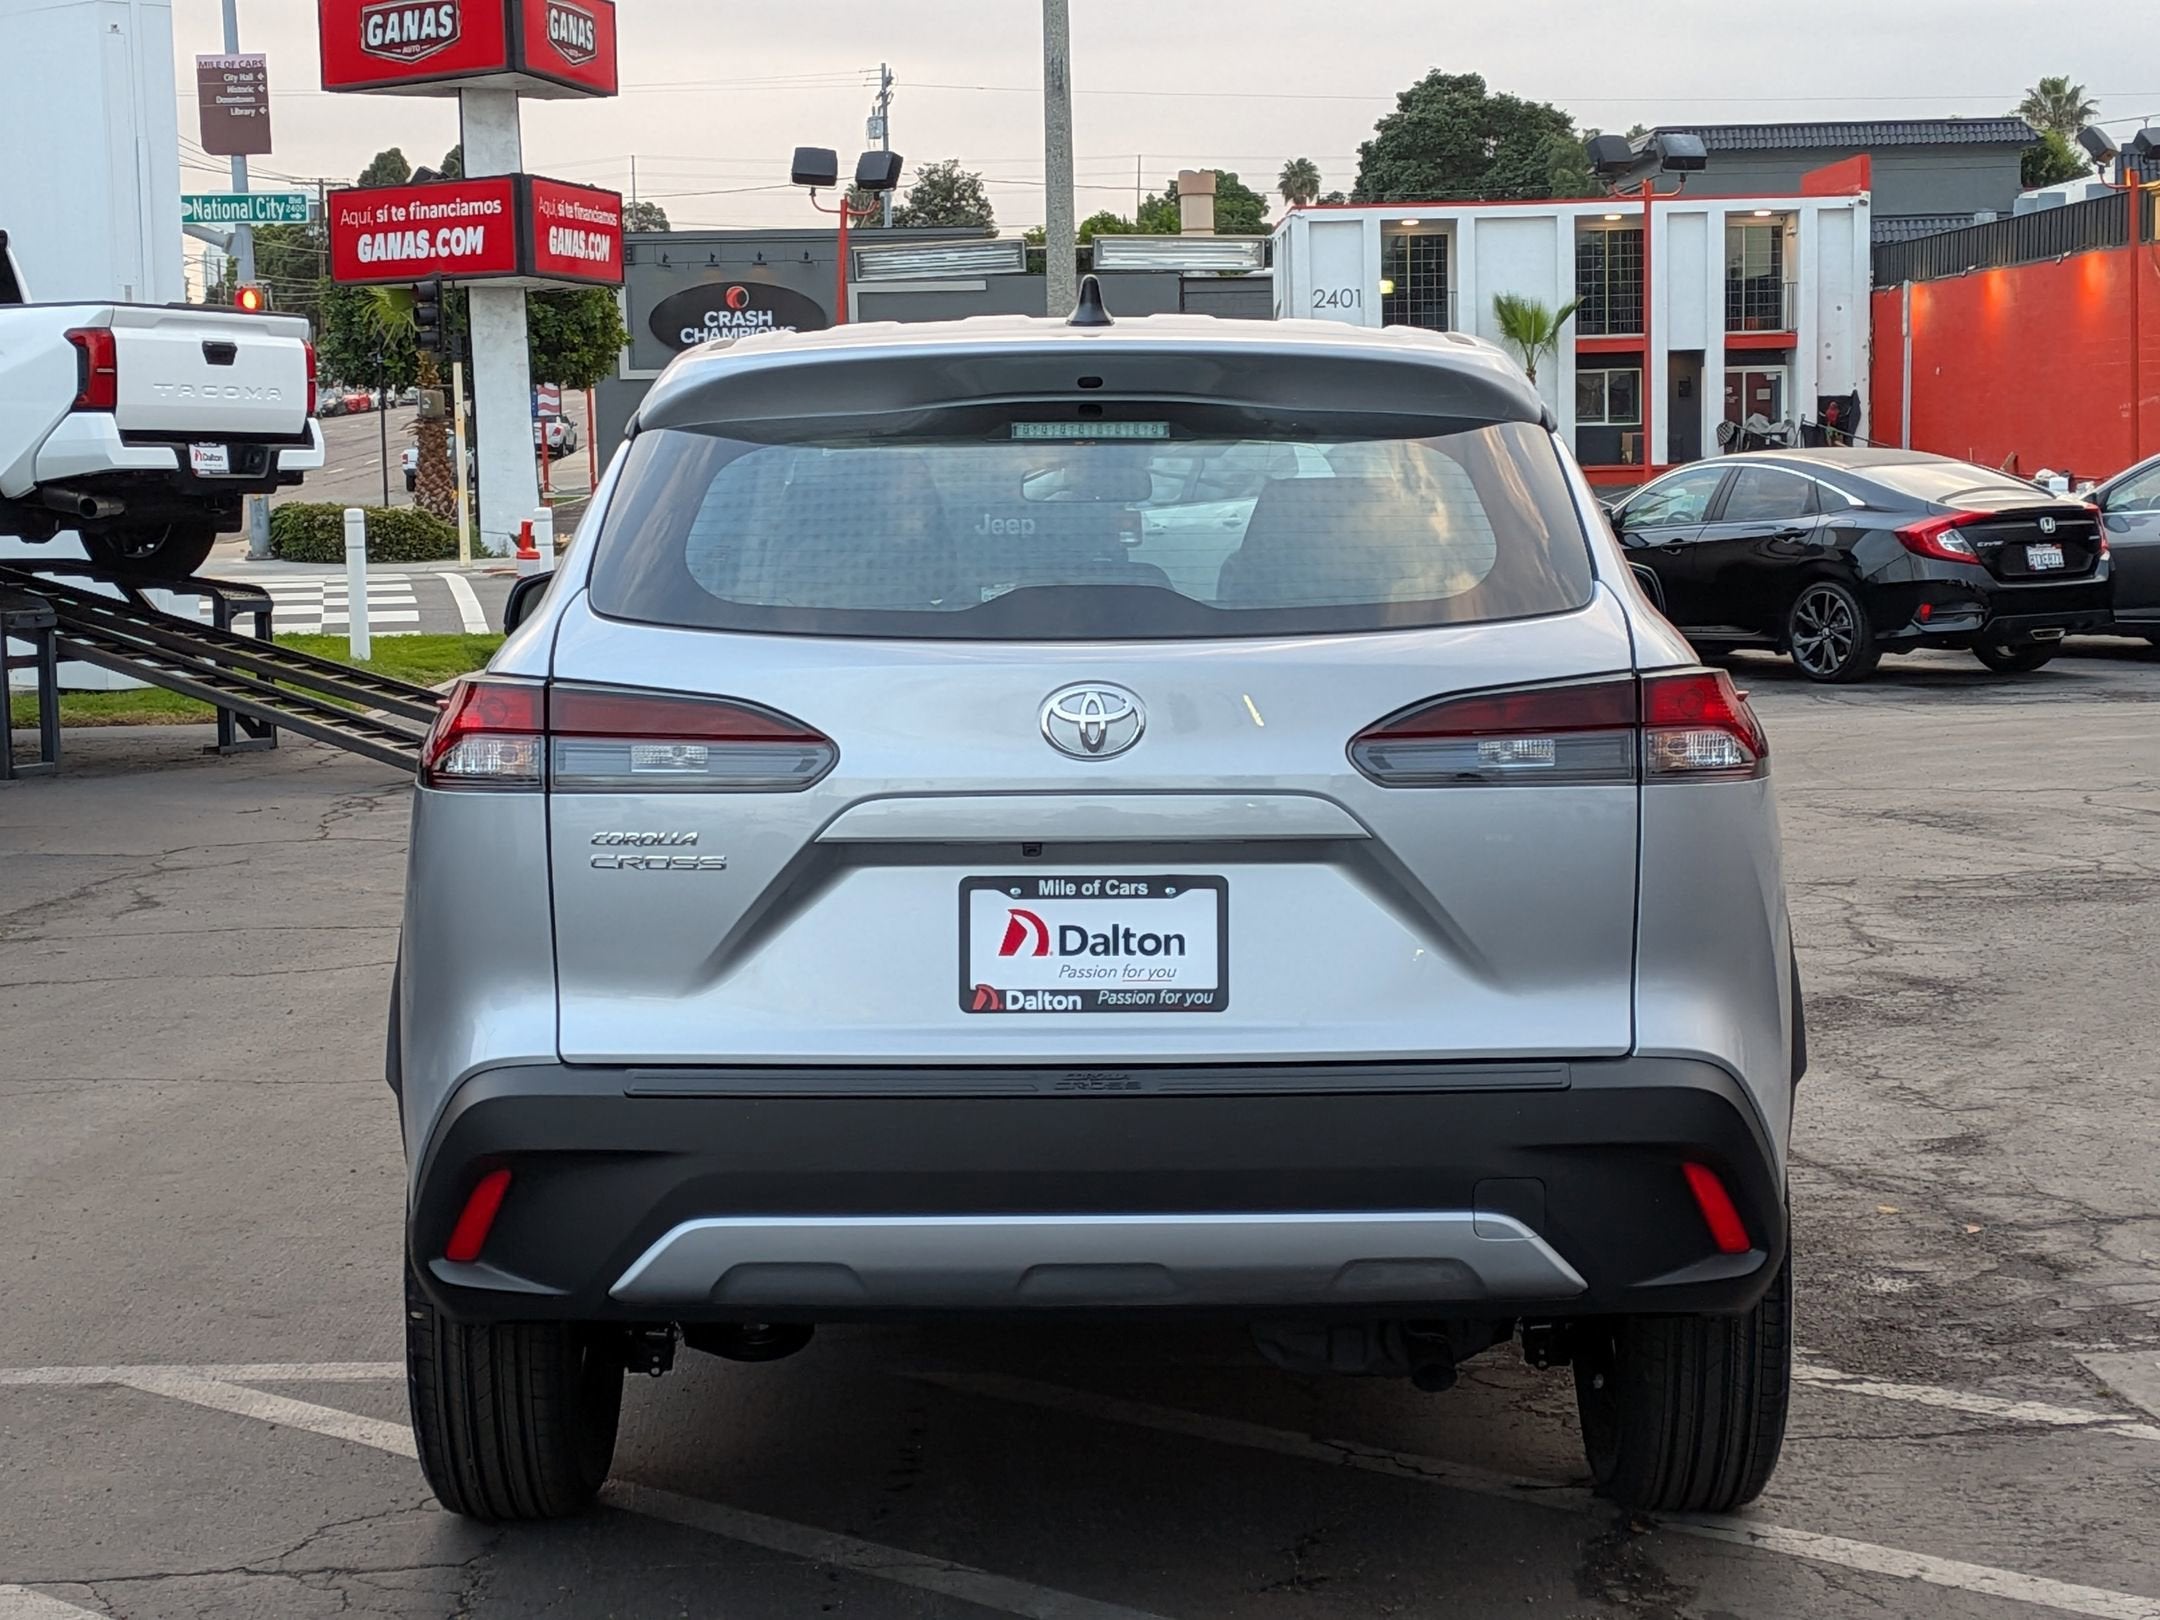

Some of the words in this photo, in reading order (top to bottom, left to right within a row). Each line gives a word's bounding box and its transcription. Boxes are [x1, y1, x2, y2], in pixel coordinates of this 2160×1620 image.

[367, 4, 454, 46] GANAS
[549, 7, 593, 51] GANAS
[402, 44, 421, 54] AUTO
[199, 61, 222, 69] MILE
[238, 60, 264, 68] CARS
[223, 73, 238, 83] City
[239, 73, 254, 81] Hall
[230, 107, 256, 117] Library
[193, 198, 253, 220] National
[256, 196, 285, 220] City
[285, 204, 306, 213] 2400
[340, 206, 374, 228] Aquí,
[376, 204, 388, 223] sí
[391, 205, 406, 222] te
[409, 198, 502, 220] financiamos
[574, 202, 618, 227] financiamos
[357, 225, 484, 263] GANAS.COM
[548, 225, 611, 262] GANAS.COM
[1312, 288, 1362, 309] 2401
[704, 310, 773, 327] CRASH
[153, 383, 282, 401] TACOMA
[974, 513, 1036, 538] Jeep
[590, 831, 700, 847] COROLLA
[590, 854, 728, 871] CROSS
[1038, 879, 1077, 896] Mile
[1081, 879, 1102, 896] of
[1105, 879, 1149, 896] Cars
[1058, 923, 1186, 957] Dalton
[1058, 964, 1117, 979] Passion
[1122, 964, 1145, 979] for
[1147, 968, 1177, 981] you
[1005, 991, 1082, 1011] Dalton
[1097, 990, 1151, 1005] Passion
[1158, 990, 1180, 1005] for
[1183, 994, 1214, 1008] you
